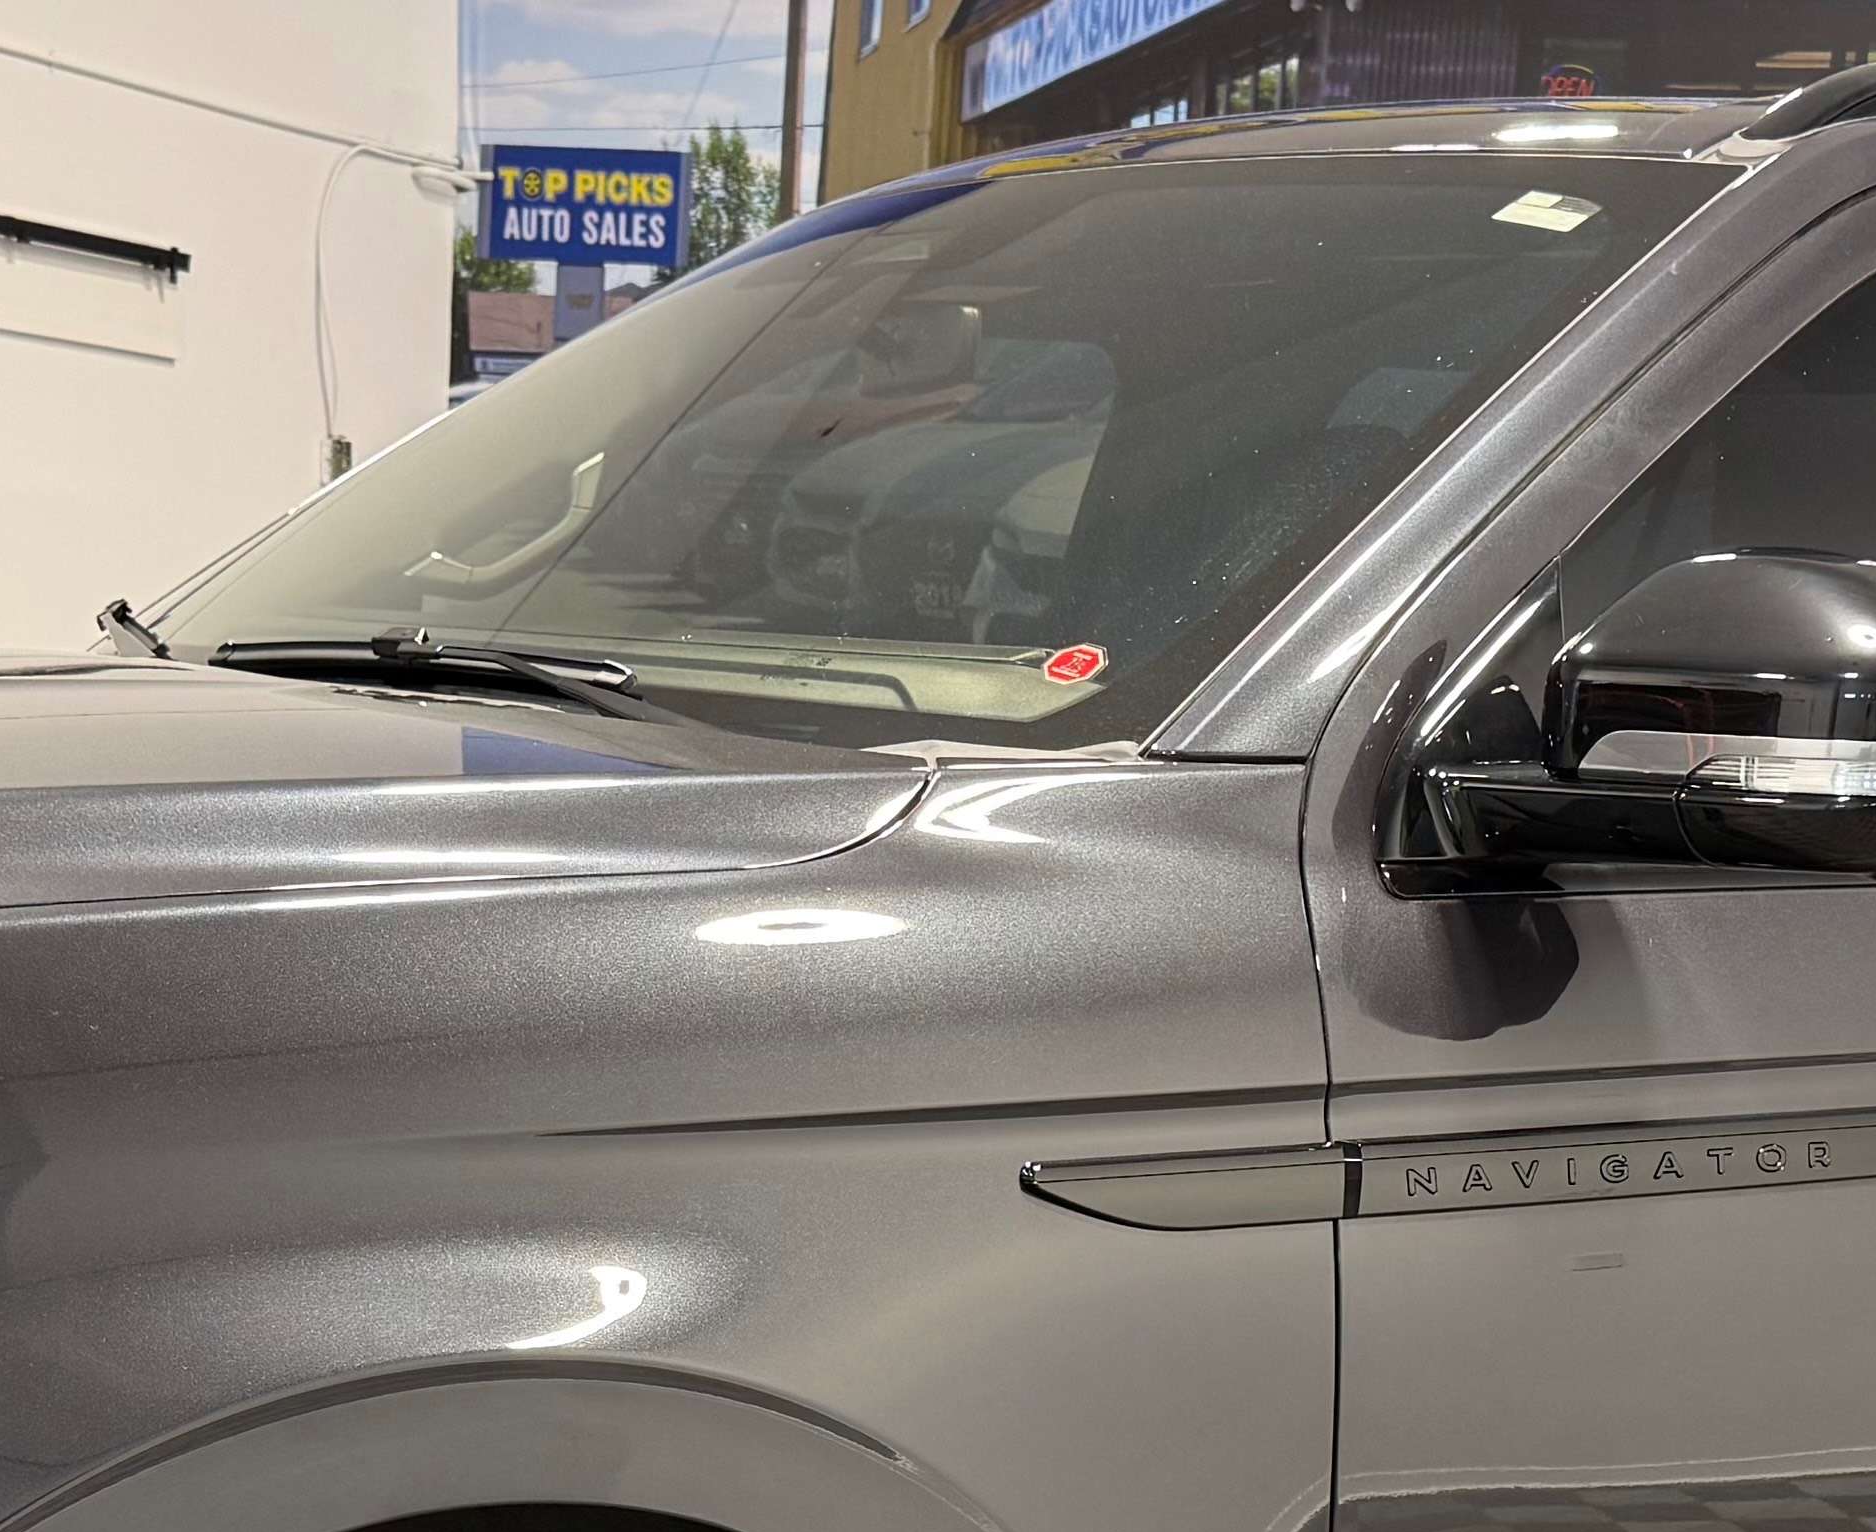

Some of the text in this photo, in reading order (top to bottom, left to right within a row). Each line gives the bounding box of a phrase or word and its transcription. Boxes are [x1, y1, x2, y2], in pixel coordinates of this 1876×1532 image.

[574, 169, 675, 207] PICKS
[502, 206, 667, 249] AUTO SALES
[1405, 1141, 1833, 1197] NAVIGATOR
